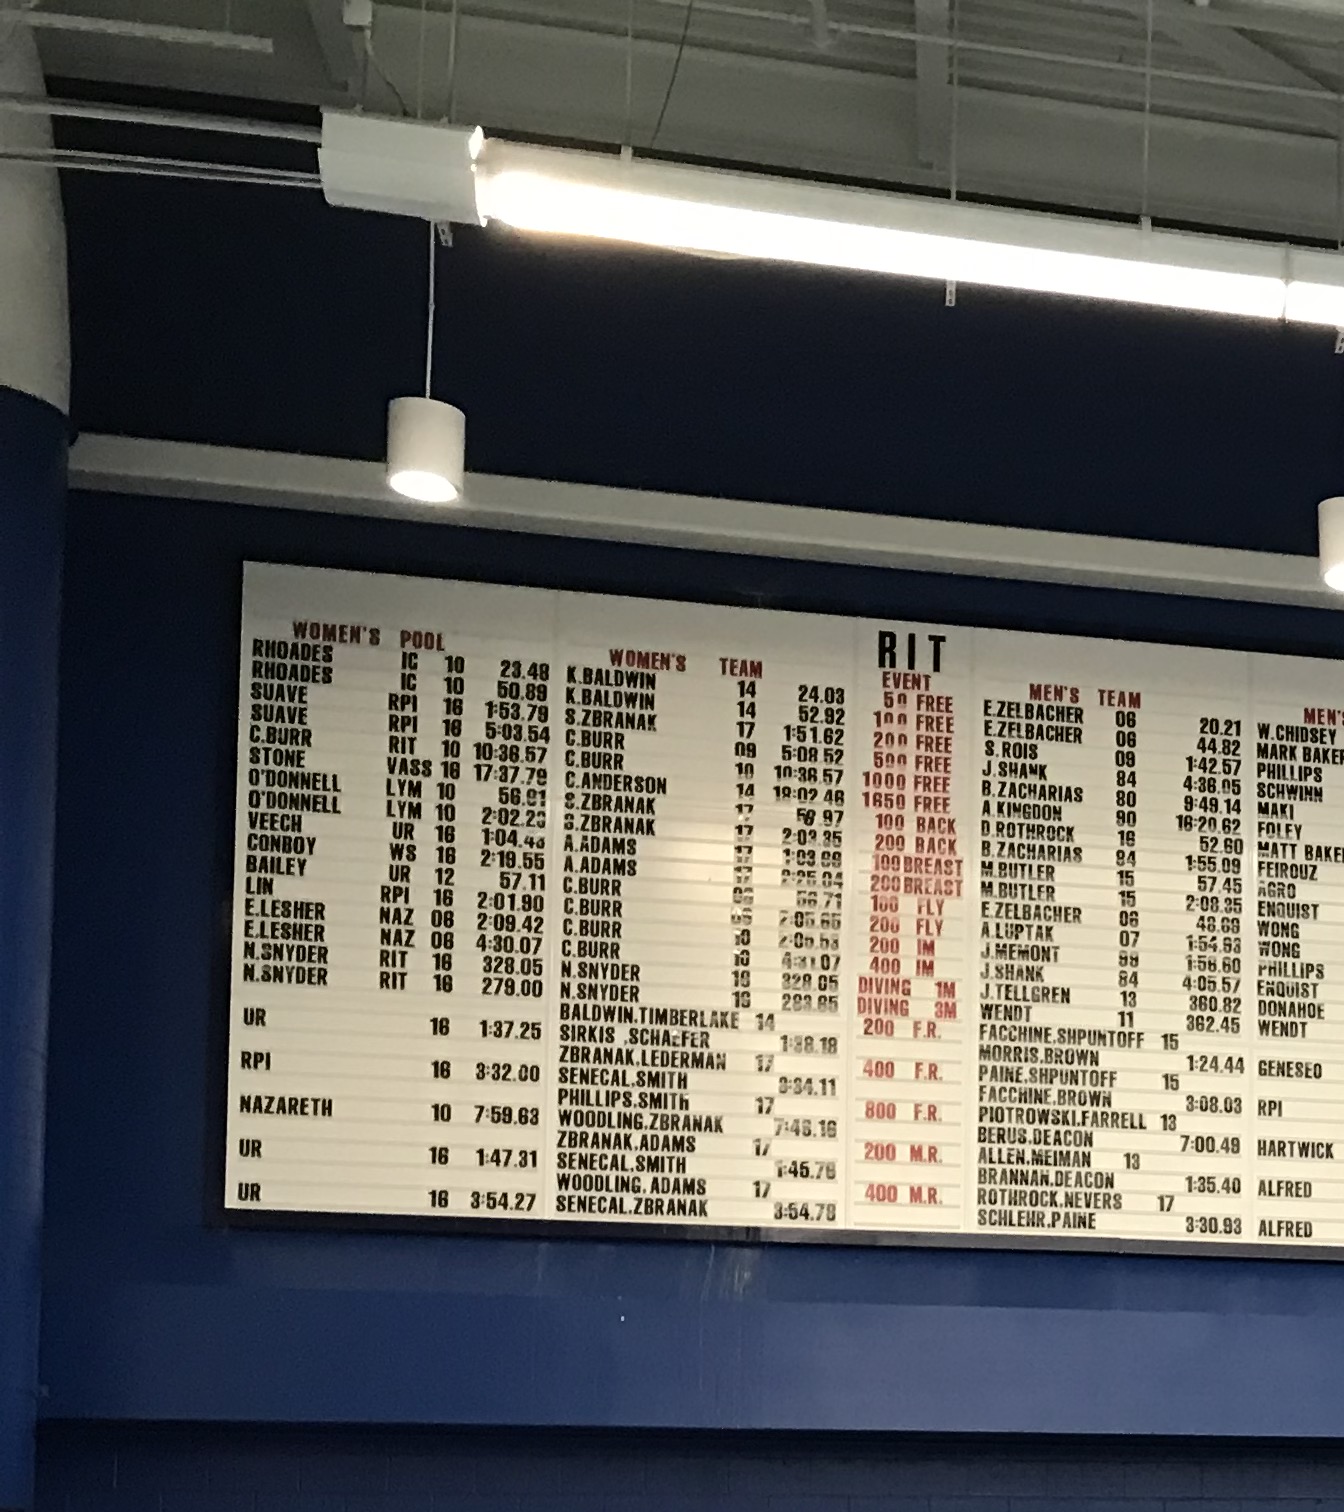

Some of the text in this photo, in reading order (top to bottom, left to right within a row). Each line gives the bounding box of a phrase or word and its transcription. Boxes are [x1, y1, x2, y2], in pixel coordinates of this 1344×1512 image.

[293, 621, 444, 651] WOMEN'S POOL
[252, 639, 333, 663] RHOADES
[402, 652, 418, 671] IC
[445, 655, 465, 673] 10
[610, 649, 762, 679] WOMEN'S TEAM
[252, 661, 416, 691] RHOADES IC
[567, 665, 844, 704] K.BALDWIN 14 24.03
[882, 671, 931, 692] EVENT
[251, 682, 417, 712] SUAVE RPI
[566, 687, 655, 711] K.BALDWIN
[1029, 683, 1141, 709] MEN'S TEAM
[251, 704, 417, 733] SUAVE RPI
[565, 708, 657, 732] S.ZBRANAK
[983, 699, 1241, 736] E.ZELBACHER 20.21
[250, 725, 416, 754] C.BURR RIT
[566, 729, 624, 750] C.BURR
[1258, 723, 1337, 745] W.CHIDSEY
[985, 742, 1038, 759] S.ROIS
[1197, 738, 1240, 756] 44.82
[1257, 743, 1297, 762] MARK
[250, 747, 432, 777] STONE VASS
[982, 762, 1047, 781] J.SHANK
[249, 769, 422, 798] O'DONNELL LYM
[565, 771, 667, 795] C.ANDERSON
[1257, 763, 1322, 783] PHILLIPS
[982, 781, 1083, 803] B.ZACHARIAS
[1257, 783, 1323, 802] SCHWINN
[249, 790, 422, 820] O'DONNELL LYM
[565, 792, 655, 815] S.ZBRANAK
[982, 803, 1062, 822] A.KINGDON
[1258, 802, 1294, 820] MAKI
[249, 812, 414, 841] VEECH UR
[917, 817, 955, 835] BACK
[1258, 822, 1302, 840] FOLEY
[247, 834, 416, 862] CONBOY WS
[564, 834, 636, 856] A.ADAMS
[1258, 842, 1297, 859] MATT
[246, 855, 545, 891] BAILEY UR 12 57.11
[564, 856, 636, 877] A.ADAMS
[1258, 861, 1317, 882] FEIROUZ
[563, 877, 621, 896] C.BURR
[981, 861, 1242, 894] M.BUTLER 57.45
[246, 877, 409, 904] LIN RPI
[245, 898, 414, 926] E.LESHER NAZ
[982, 903, 1081, 923] E.ZELBACHER
[1258, 901, 1319, 920] ENQUIST
[244, 920, 415, 948] E.LESHER NAZ
[1257, 921, 1299, 939] WONG
[243, 941, 408, 969] N.SNYDER RIT
[562, 940, 620, 960] C.BURR
[1258, 941, 1300, 959] WONG
[243, 964, 407, 991] N.SNYDER RIT
[561, 961, 640, 982] N.SNYDER
[870, 958, 934, 977] 400 IM
[1258, 961, 1324, 980] PHILLIPS
[560, 982, 639, 1003] N.SNYDER
[858, 976, 955, 998] DIVING 1M
[980, 985, 1070, 1004] J.TELLGREN
[980, 1003, 1032, 1022] WENDT
[1258, 1000, 1325, 1020] DONAHOE
[244, 1008, 541, 1040] UR 1:37.25
[1258, 1020, 1308, 1038] WENDT
[241, 1051, 270, 1070] RPI
[1259, 1060, 1322, 1079] GENESEO
[240, 1095, 332, 1117] NAZARETH
[1258, 1100, 1282, 1117] RPI
[239, 1139, 261, 1158] UR
[1258, 1140, 1334, 1159] HARTWICK
[238, 1183, 260, 1202] UR
[1258, 1180, 1312, 1198] ALFRED
[1259, 1220, 1312, 1238] ALFRED
